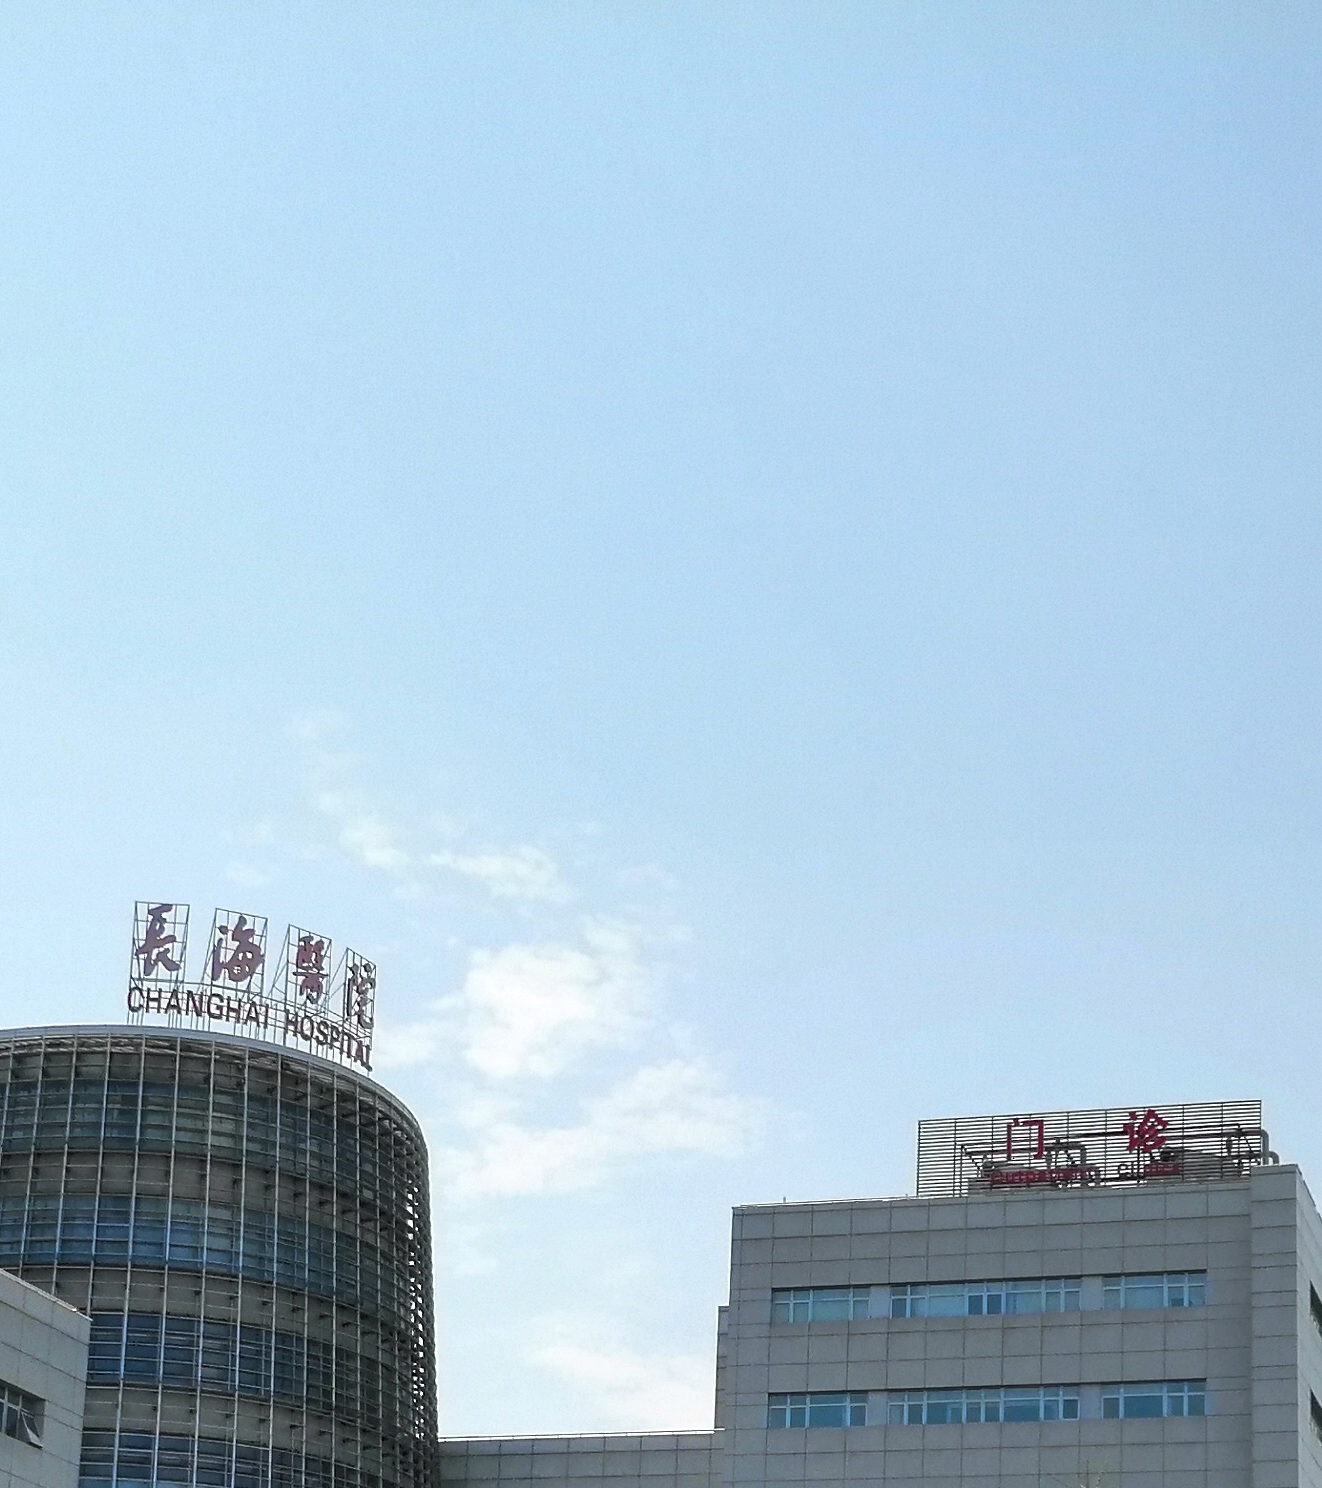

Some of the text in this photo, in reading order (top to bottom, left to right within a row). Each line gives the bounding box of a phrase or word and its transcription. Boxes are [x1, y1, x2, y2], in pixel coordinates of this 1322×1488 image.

[127, 987, 373, 1071] CHANGHAI HOSPITAL
[1007, 1109, 1169, 1160] 门诊
